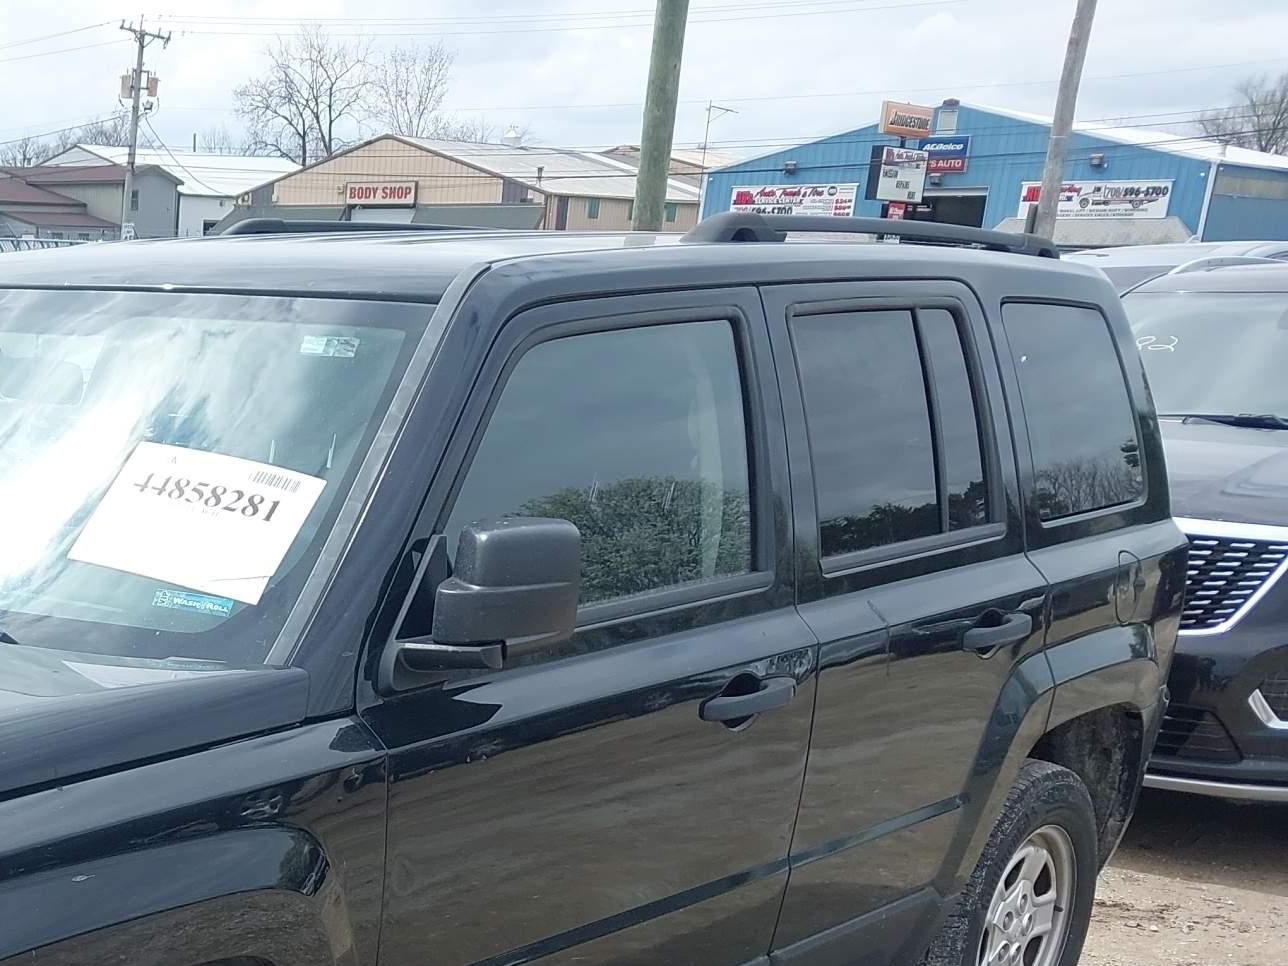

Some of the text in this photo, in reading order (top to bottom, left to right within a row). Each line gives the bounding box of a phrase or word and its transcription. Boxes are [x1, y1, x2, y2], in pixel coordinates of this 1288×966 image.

[923, 143, 963, 151] ACDelco
[938, 159, 962, 168] AUTO
[349, 186, 412, 200] BODY SHOP
[134, 472, 280, 522] 44858281
